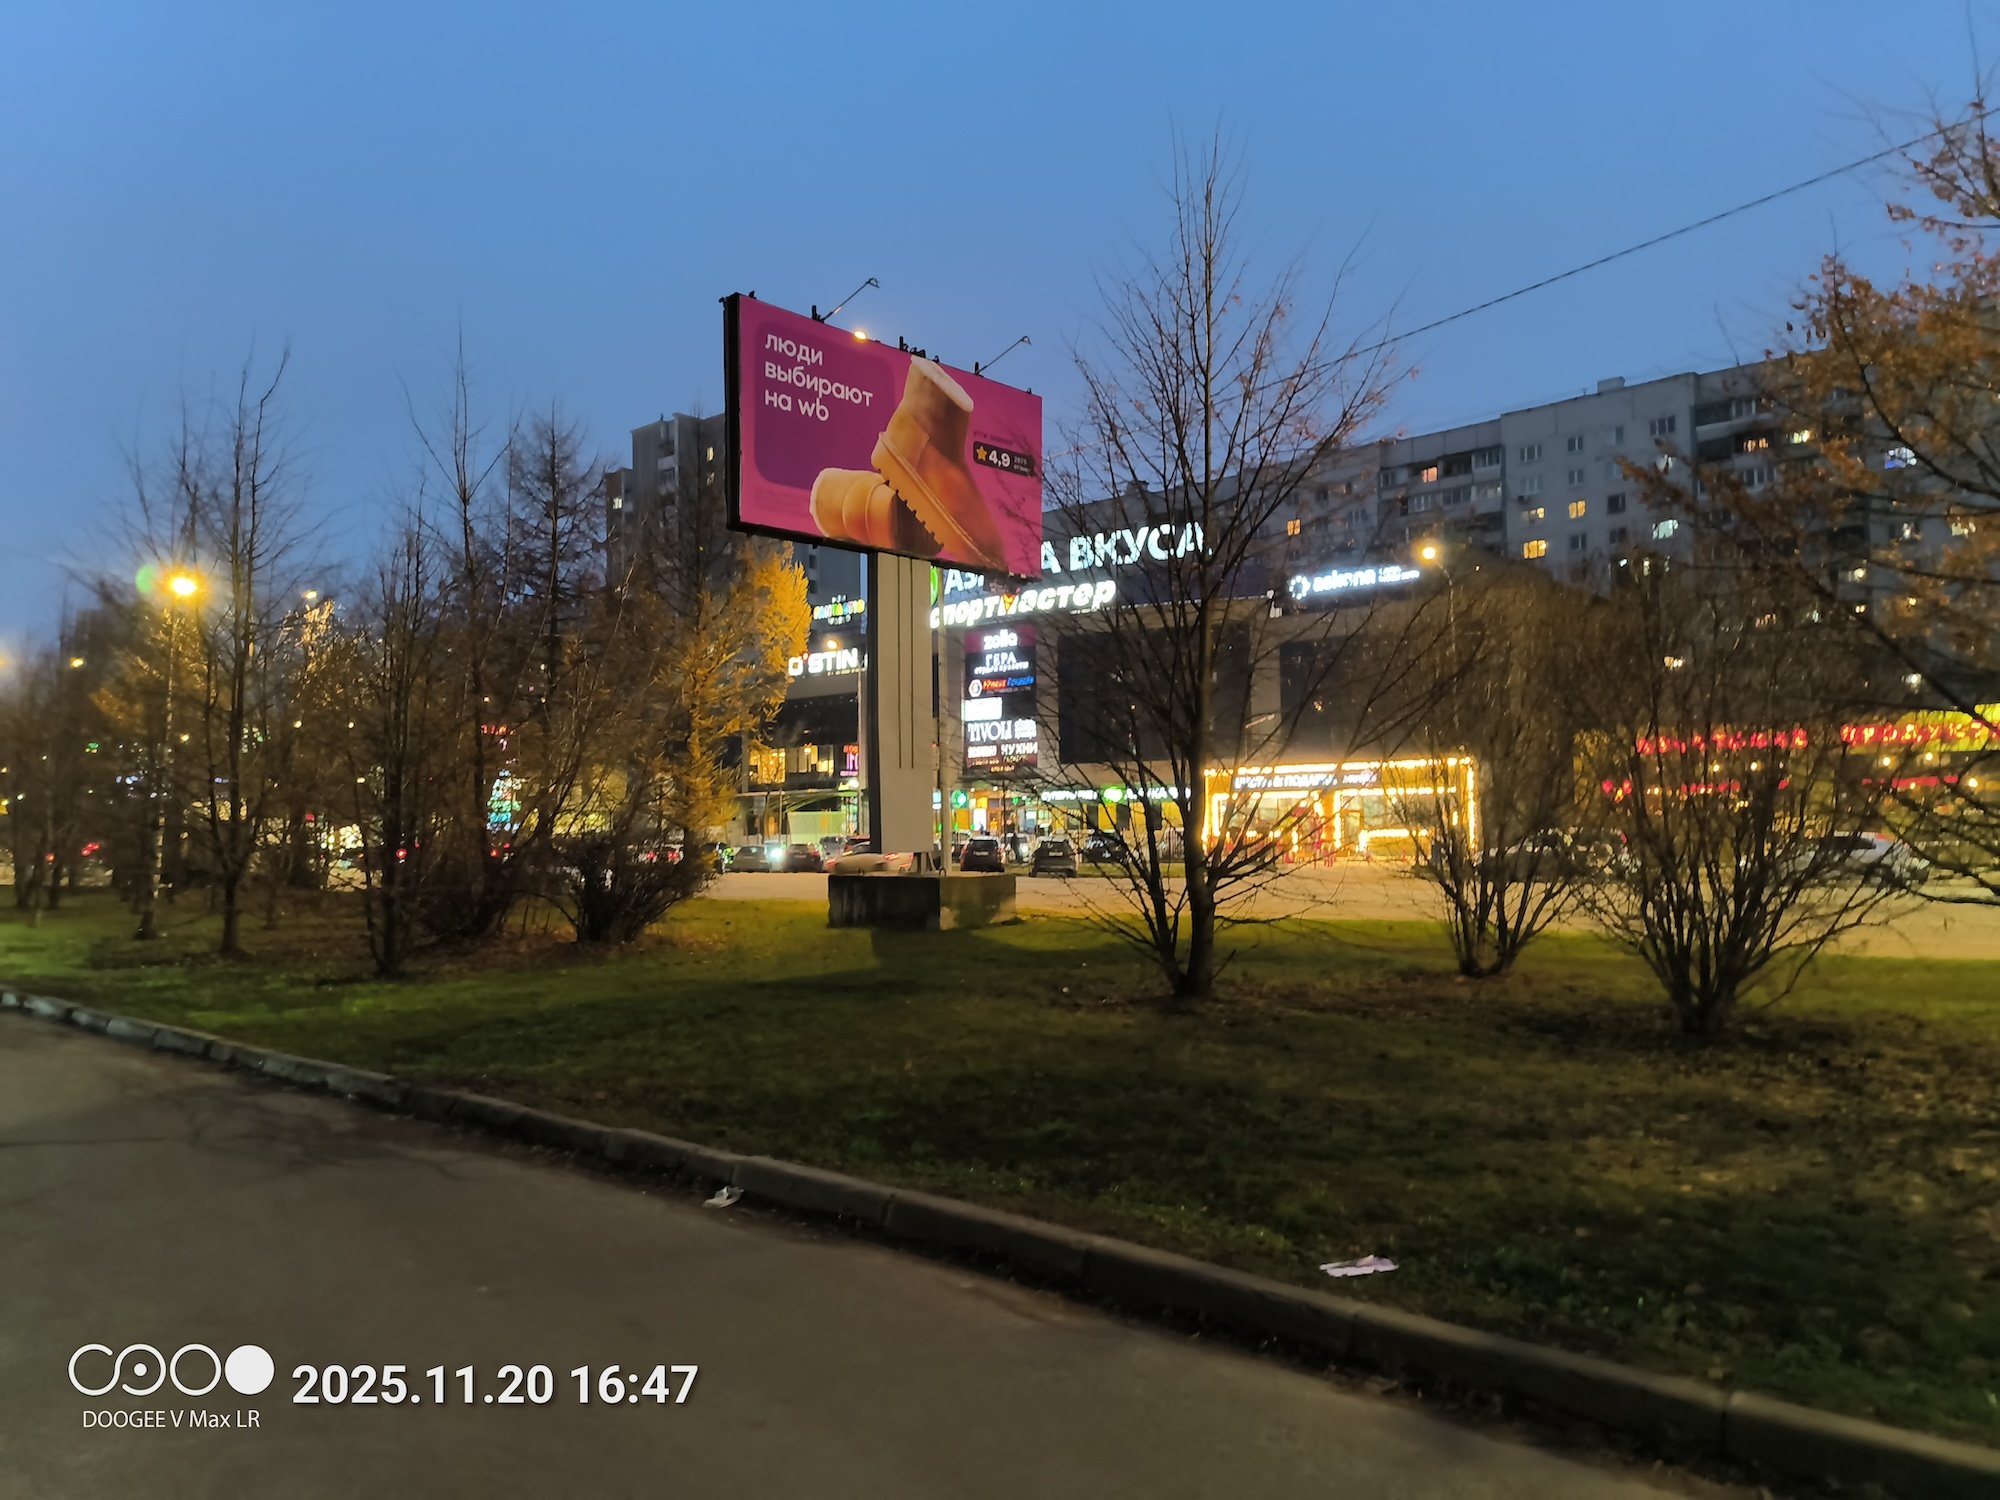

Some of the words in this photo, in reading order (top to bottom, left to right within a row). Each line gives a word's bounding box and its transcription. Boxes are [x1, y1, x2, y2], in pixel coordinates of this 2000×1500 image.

[764, 333, 824, 366] люди
[763, 361, 874, 407] выбирают
[763, 389, 793, 413] на
[797, 397, 830, 422] wb
[988, 449, 1011, 468] 4,9
